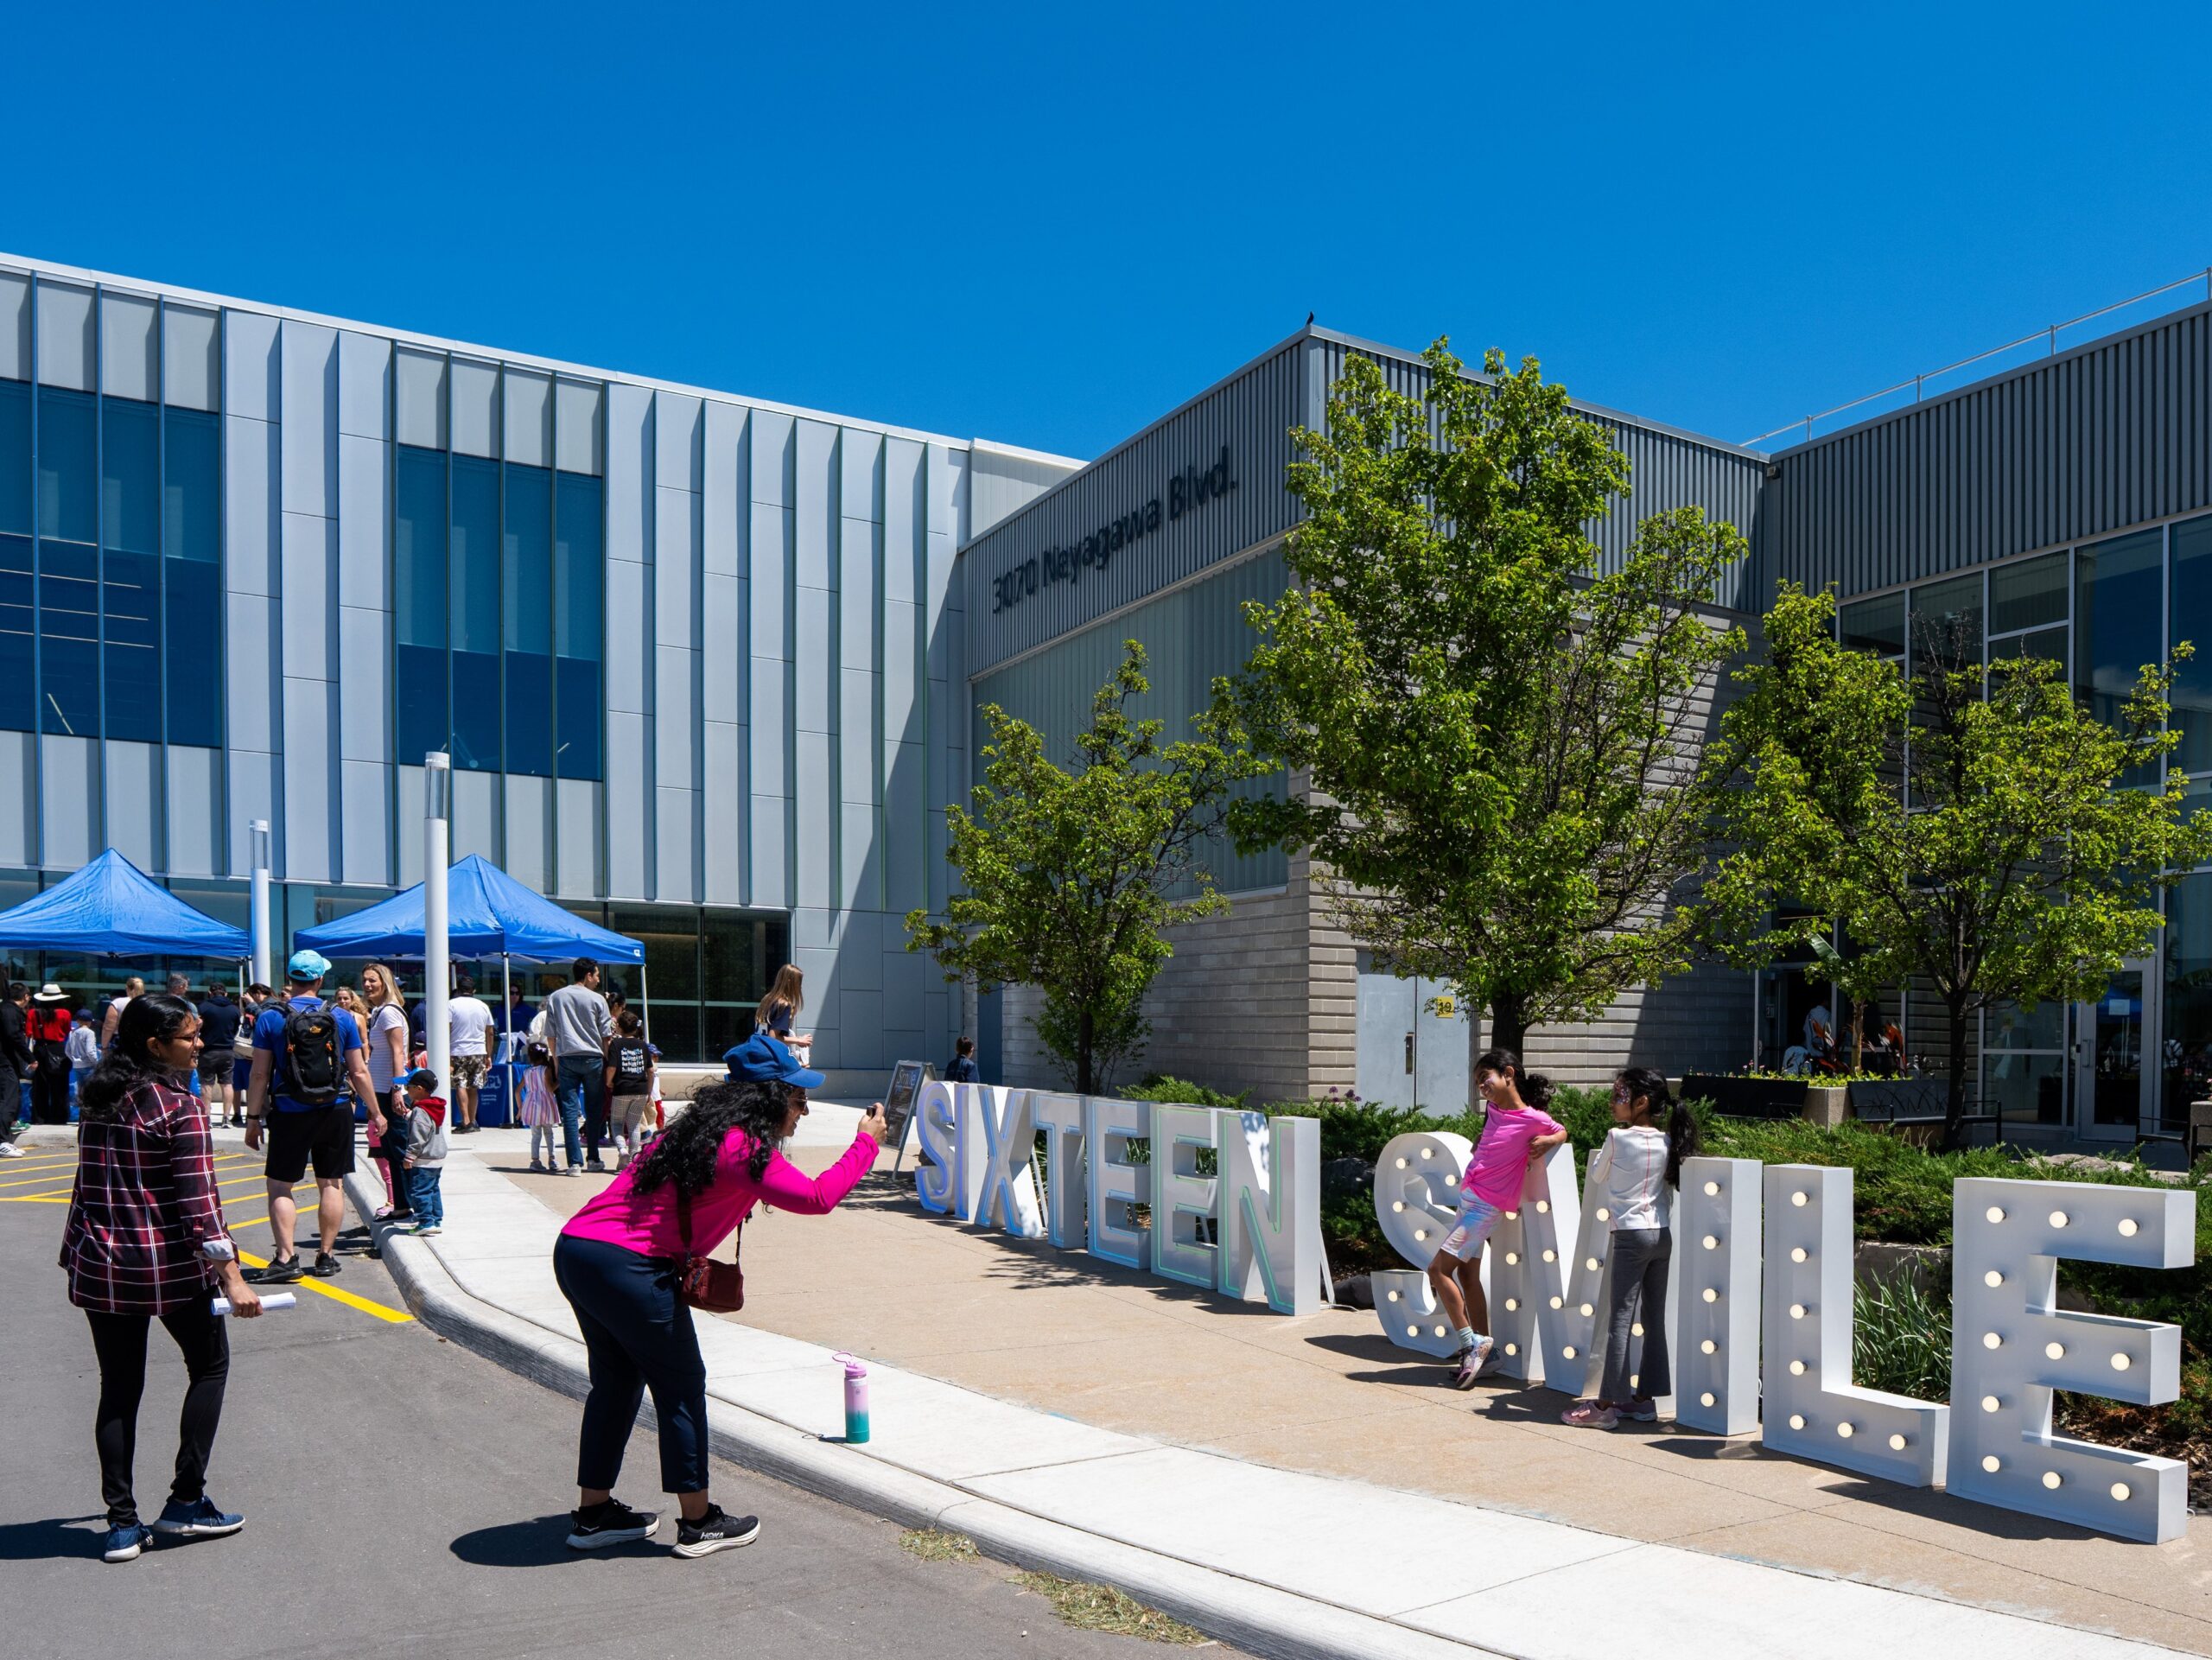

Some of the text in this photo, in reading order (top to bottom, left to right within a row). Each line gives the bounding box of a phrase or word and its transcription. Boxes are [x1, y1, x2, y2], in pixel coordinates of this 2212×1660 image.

[992, 445, 1237, 614] 3070 Neyagawa Blvd.
[915, 1080, 1321, 1317] SIXTEEN
[1371, 1130, 2196, 1545] SMILE
[700, 1530, 724, 1541] HOKA
